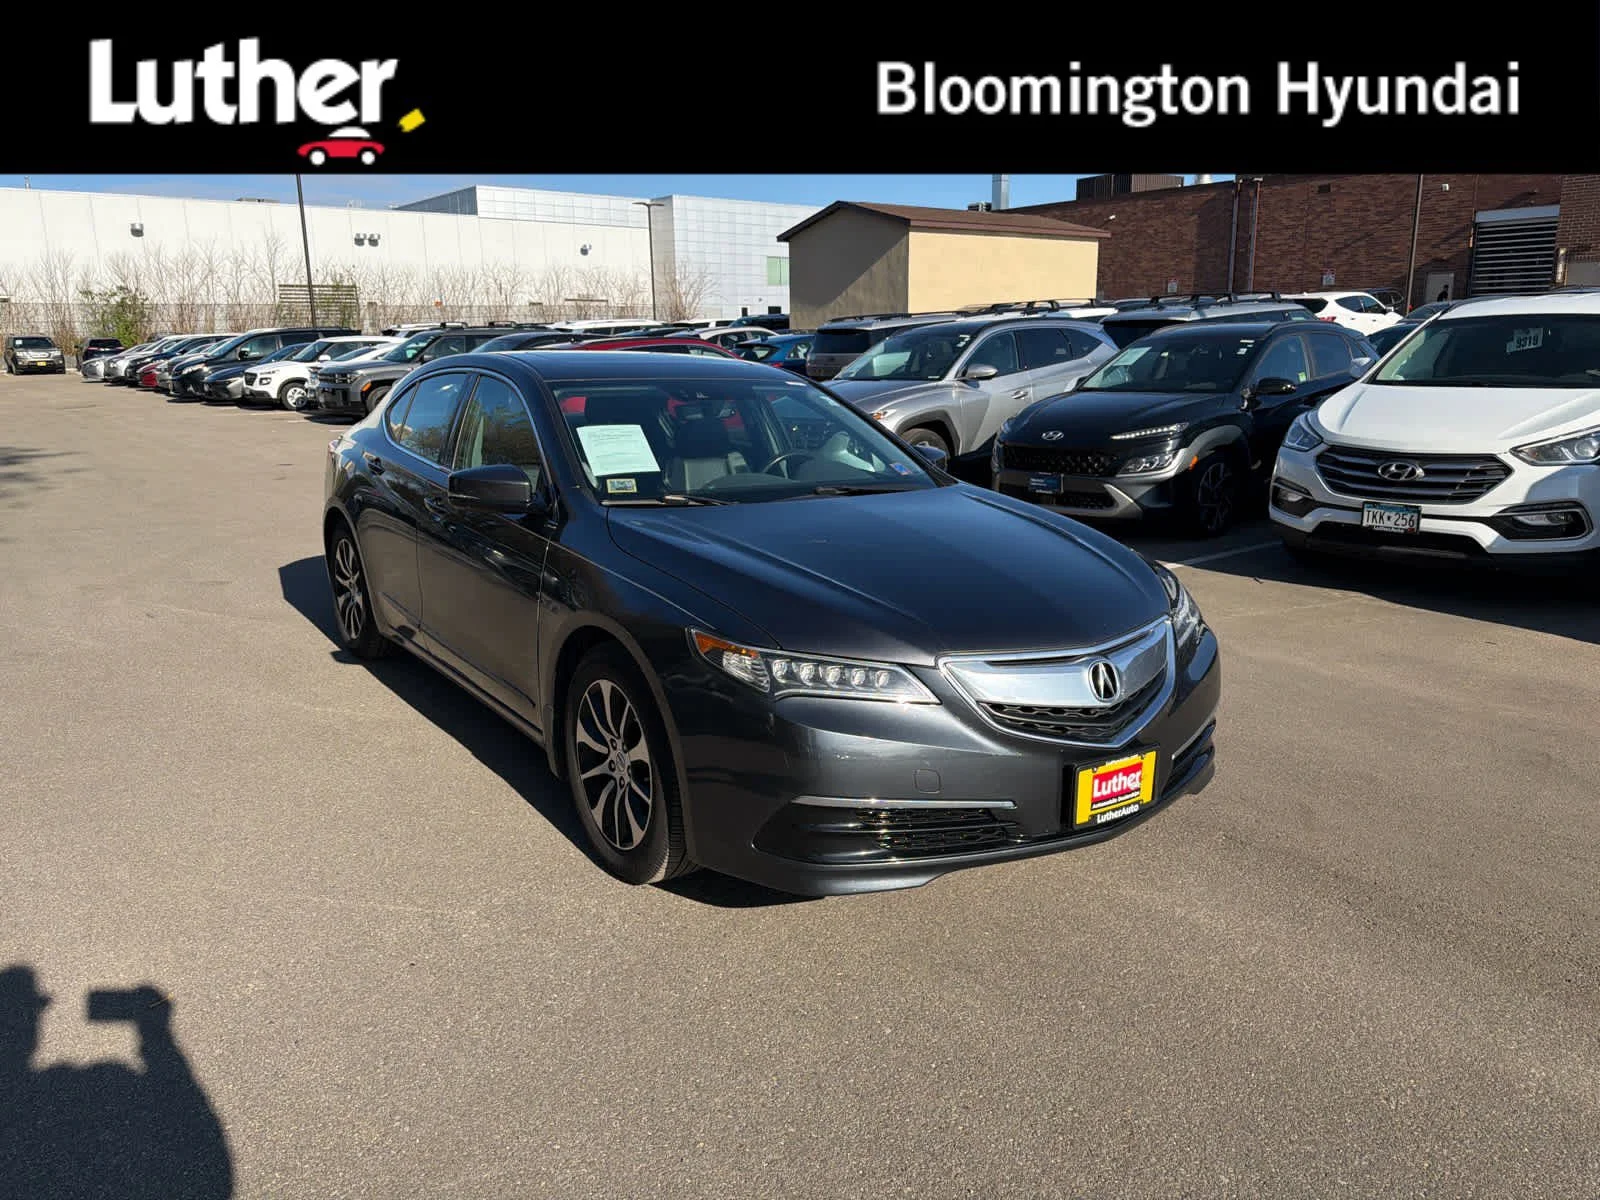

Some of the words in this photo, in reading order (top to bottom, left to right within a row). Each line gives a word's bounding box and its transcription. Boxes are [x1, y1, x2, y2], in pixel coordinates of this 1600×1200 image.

[1366, 510, 1386, 525] TKK
[1394, 512, 1416, 528] 256
[1092, 770, 1142, 799] Luther
